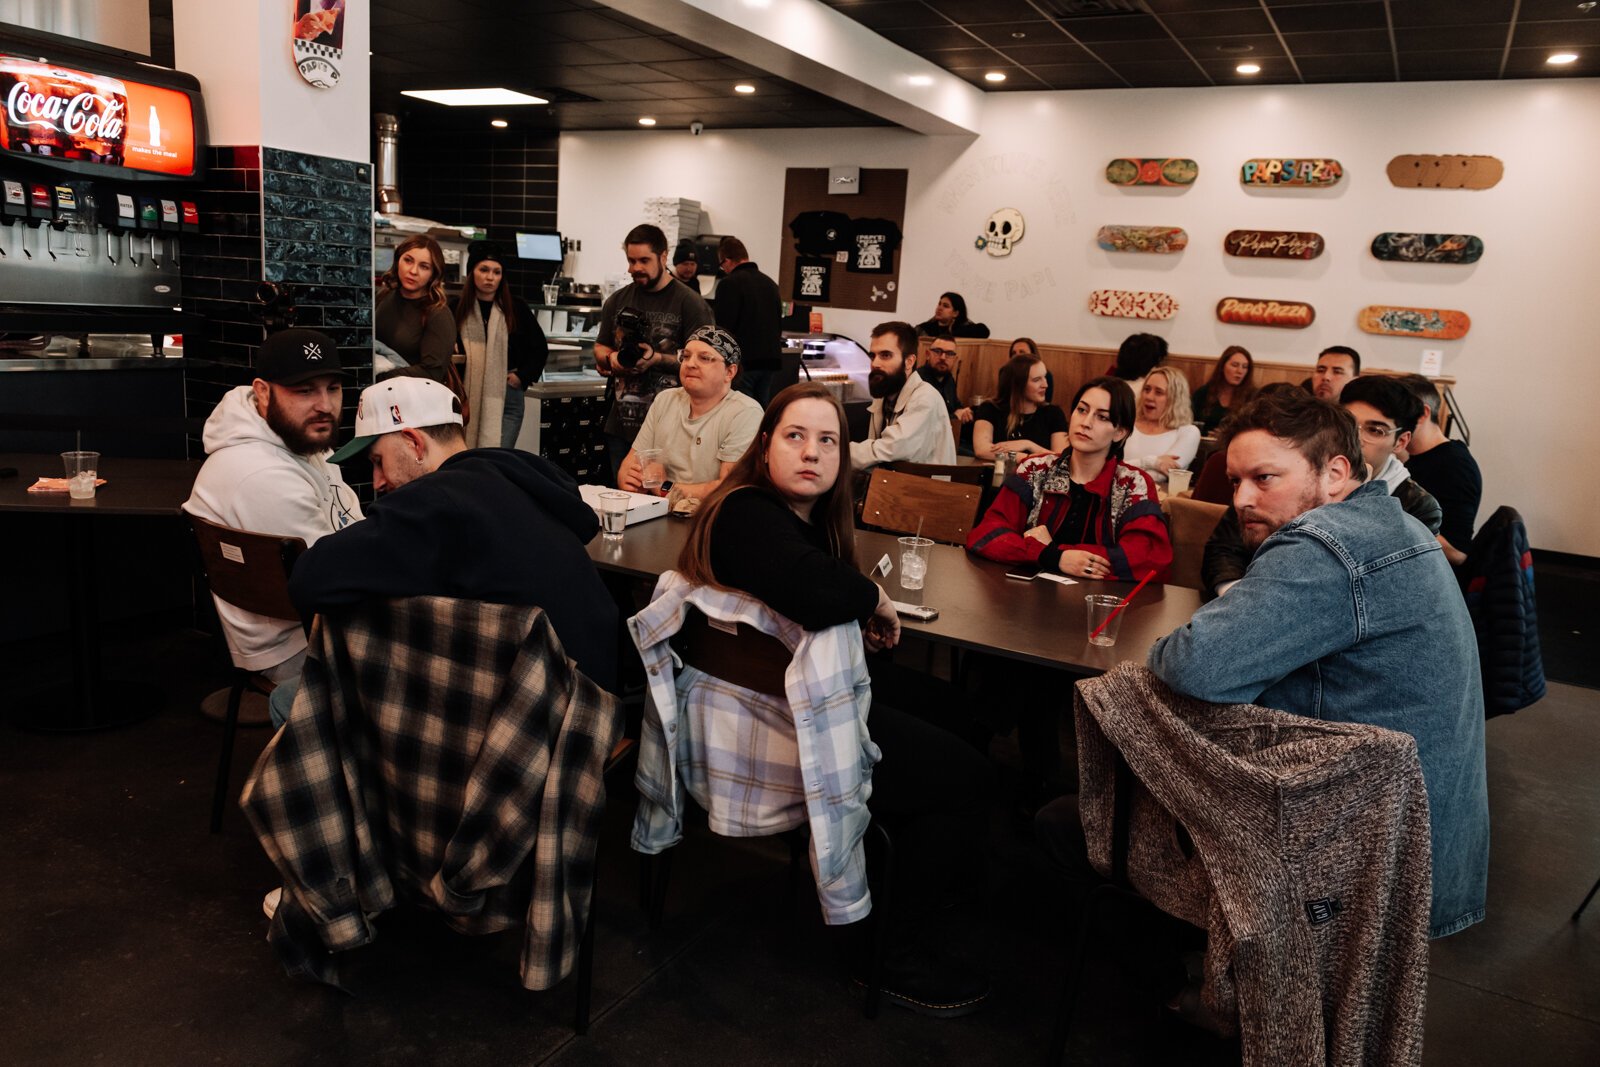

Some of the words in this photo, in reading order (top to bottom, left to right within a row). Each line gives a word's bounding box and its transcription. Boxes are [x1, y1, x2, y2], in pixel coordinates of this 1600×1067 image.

[7, 81, 125, 140] Coca-Cola
[132, 146, 152, 156] makes
[152, 149, 162, 157] the
[163, 151, 178, 159] meal
[1003, 266, 1058, 302] PAPI
[1263, 301, 1309, 319] PIZZA
